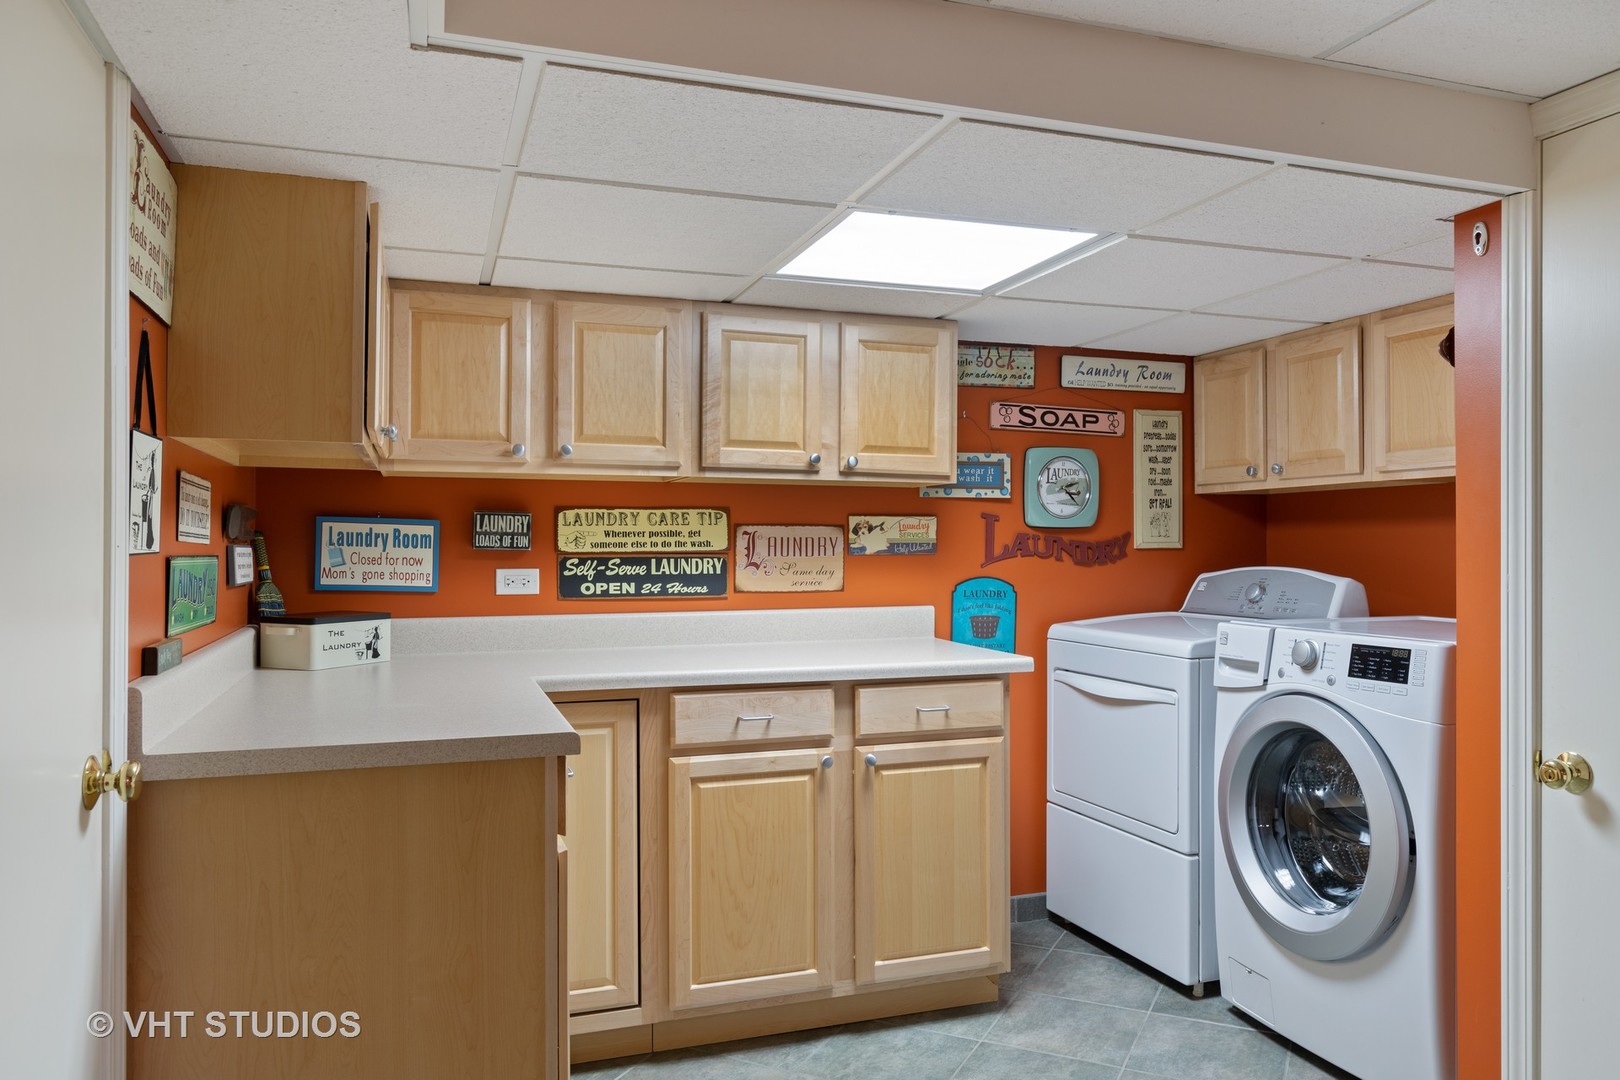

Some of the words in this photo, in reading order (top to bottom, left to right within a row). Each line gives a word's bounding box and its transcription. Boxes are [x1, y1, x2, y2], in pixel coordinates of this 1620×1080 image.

[148, 199, 167, 239] Room
[130, 222, 147, 251] oads
[1075, 361, 1129, 383] Laundry
[1137, 365, 1172, 382] Room
[1018, 405, 1099, 428] SOAP
[959, 474, 981, 482] wash
[986, 474, 993, 482] it
[988, 466, 995, 475] it
[1045, 467, 1081, 485] LAUNDRY
[476, 514, 529, 533] LAUNDRY
[561, 511, 640, 527] LAUNDRY
[647, 511, 690, 526] CARE
[696, 511, 724, 526] TIP
[899, 522, 930, 533] Laundry
[328, 526, 389, 553] Laundry
[392, 528, 432, 549] Room
[476, 534, 501, 548] LOADS
[502, 535, 512, 548] OF
[513, 535, 529, 548] FUN
[603, 529, 646, 538] Whenever
[648, 529, 686, 540] possible,
[687, 530, 701, 540] get
[899, 531, 930, 539] SERVICES
[980, 512, 1131, 568] LAUNDRY
[590, 539, 629, 549] someone
[630, 539, 648, 549] else
[650, 539, 659, 549] to
[661, 539, 671, 549] do
[674, 538, 688, 549] the
[690, 538, 714, 549] wash.
[741, 530, 839, 572] LAUNDRY
[350, 551, 383, 566] Closed
[385, 552, 400, 566] for
[402, 556, 424, 567] now
[321, 567, 356, 580] Mom's
[361, 570, 385, 584] gone
[388, 567, 431, 585] shopping
[563, 558, 648, 581] Self-Serve
[651, 557, 724, 575] LAUNDRY
[780, 562, 814, 576] Same
[815, 565, 835, 580] day
[171, 565, 208, 609] LAUNDRY
[580, 582, 635, 595] OPEN
[641, 583, 663, 594] 24
[666, 582, 709, 594] Hours
[791, 577, 823, 587] service
[963, 589, 1009, 599] LAUNDRY
[322, 641, 362, 652] LAUNDRY
